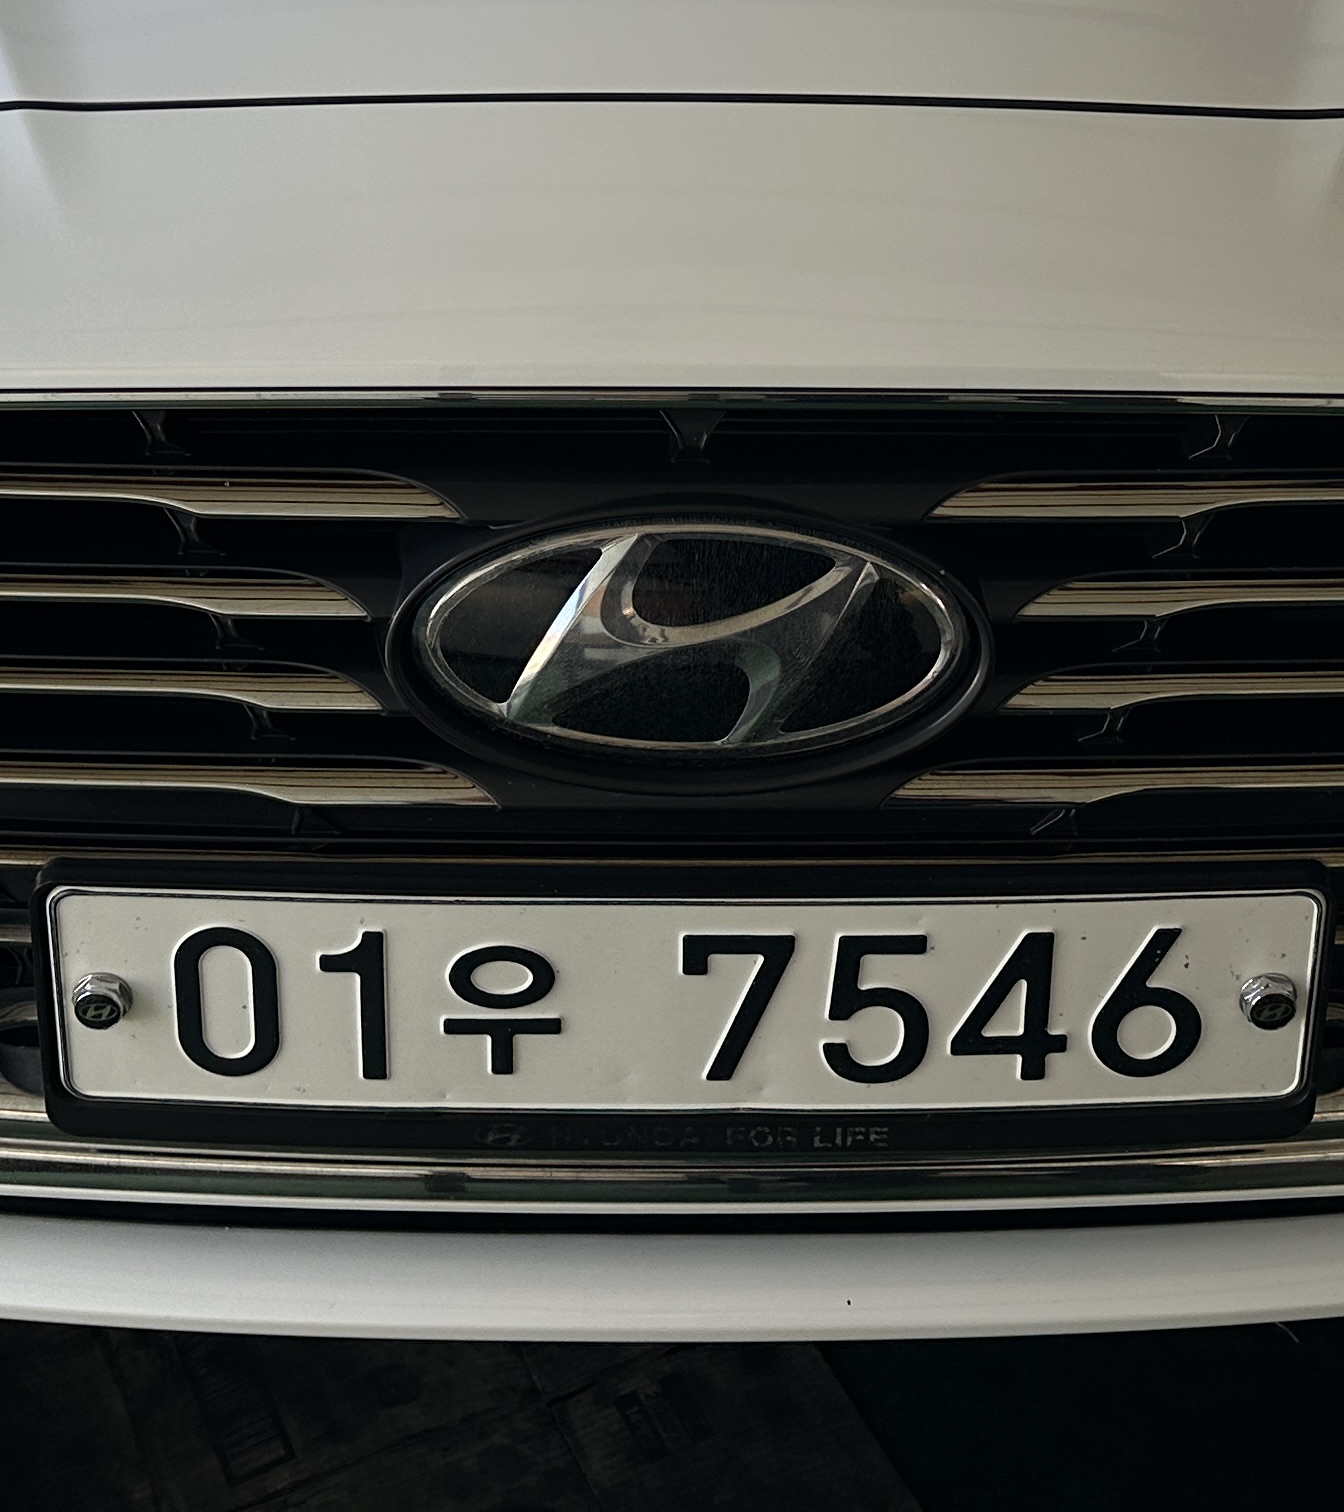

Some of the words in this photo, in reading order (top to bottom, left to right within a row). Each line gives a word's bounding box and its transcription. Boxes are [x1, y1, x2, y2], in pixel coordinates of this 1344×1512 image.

[172, 925, 564, 1082] 01우
[681, 926, 1204, 1085] 7546
[550, 1125, 713, 1148] HUNDAI
[725, 1125, 799, 1148] FOR
[812, 1125, 890, 1148] LIFE
